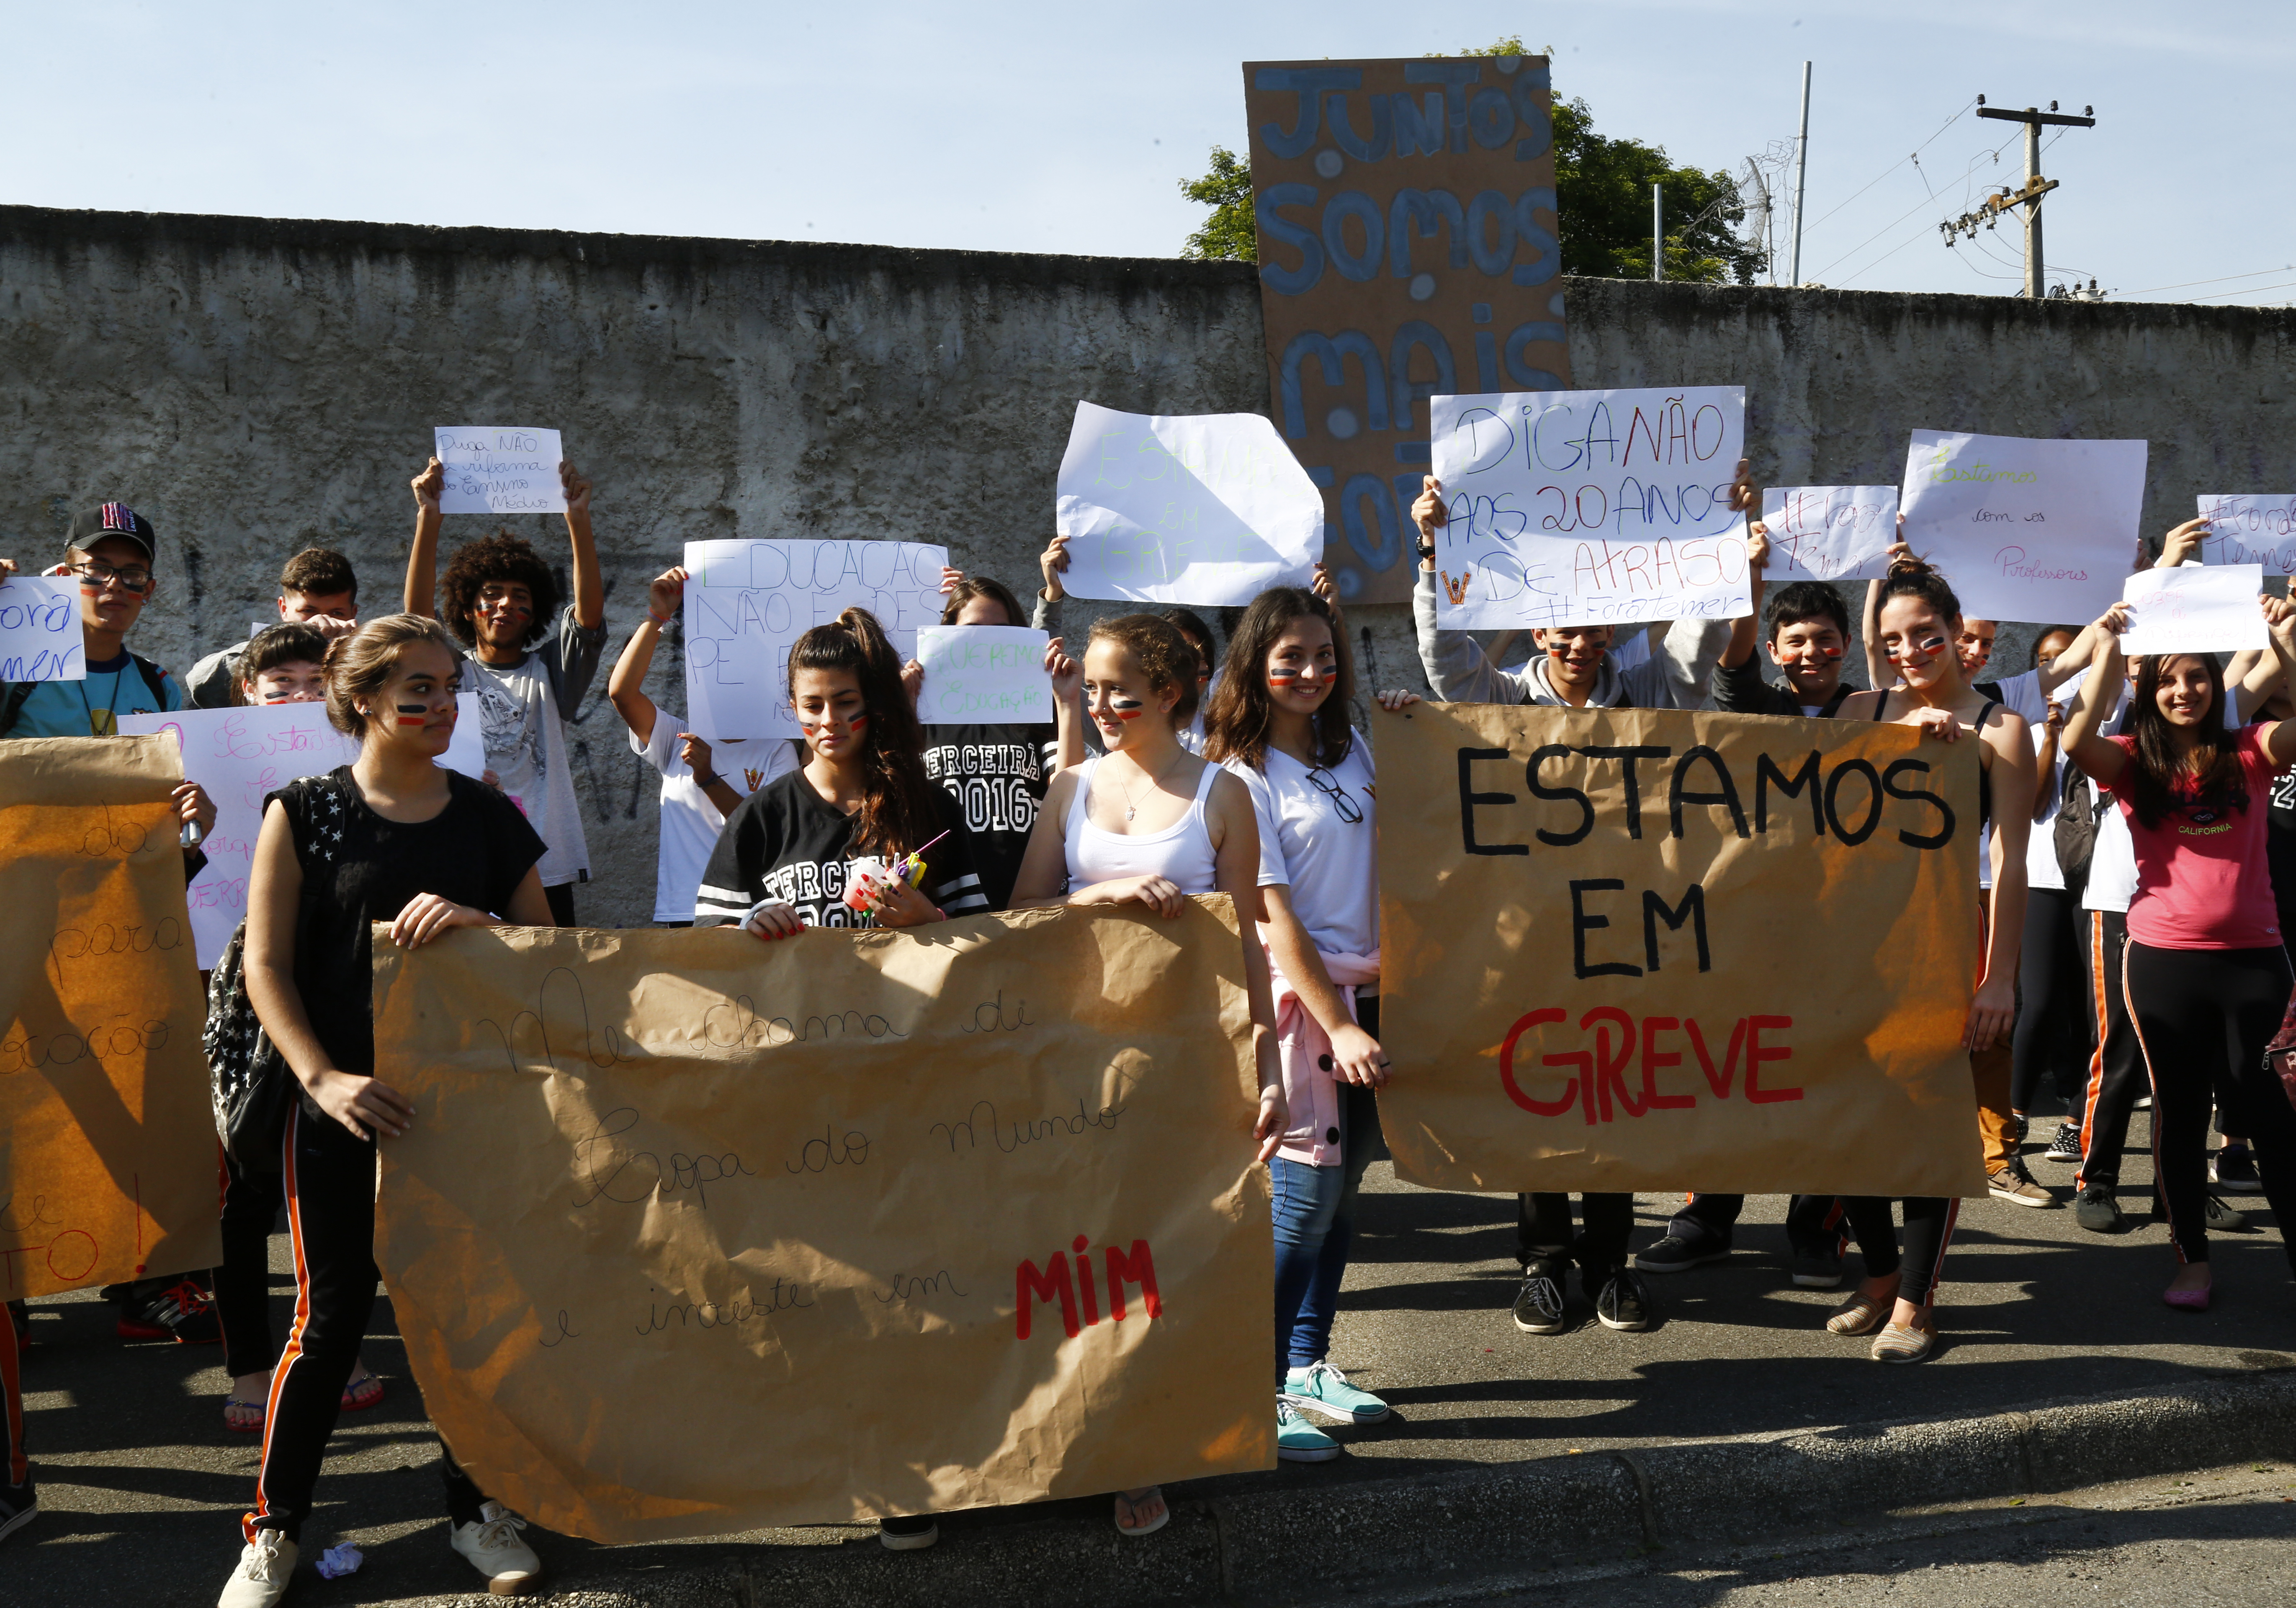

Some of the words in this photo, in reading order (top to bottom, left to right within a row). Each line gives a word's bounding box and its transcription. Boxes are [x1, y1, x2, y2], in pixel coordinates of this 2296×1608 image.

[1255, 62, 1552, 163] JUNTOS
[1257, 182, 1561, 296] SOMOS
[499, 432, 537, 452] NÃO
[1623, 394, 1724, 467] NÃO
[459, 475, 529, 495] Ensino
[1928, 446, 2036, 483] Estamos
[492, 493, 549, 509] Médio
[1159, 502, 1198, 533] EM
[1447, 489, 1527, 547] AOS
[1537, 485, 1607, 532] 20
[1613, 477, 1741, 537] ANOS
[1972, 508, 2014, 522] com
[2024, 512, 2045, 522] os
[1100, 524, 1268, 581] GREVE
[1477, 551, 1558, 602] DE
[1775, 532, 1887, 576] Temer
[1994, 546, 2088, 583] Professores
[2206, 533, 2296, 573] Teme
[696, 590, 791, 635] NÃO
[1457, 744, 1956, 856] ESTAMOS
[2178, 823, 2232, 835] CALIFORNIA
[49, 917, 183, 990] para
[1569, 878, 1711, 980] EM
[476, 967, 637, 1074] Me
[690, 994, 908, 1051] chama
[961, 989, 1036, 1032] de
[1499, 1006, 1804, 1126] GREVE
[786, 1124, 873, 1174] do
[930, 1098, 1126, 1153] Mundo
[636, 1277, 814, 1335] investe
[873, 1270, 968, 1304] em
